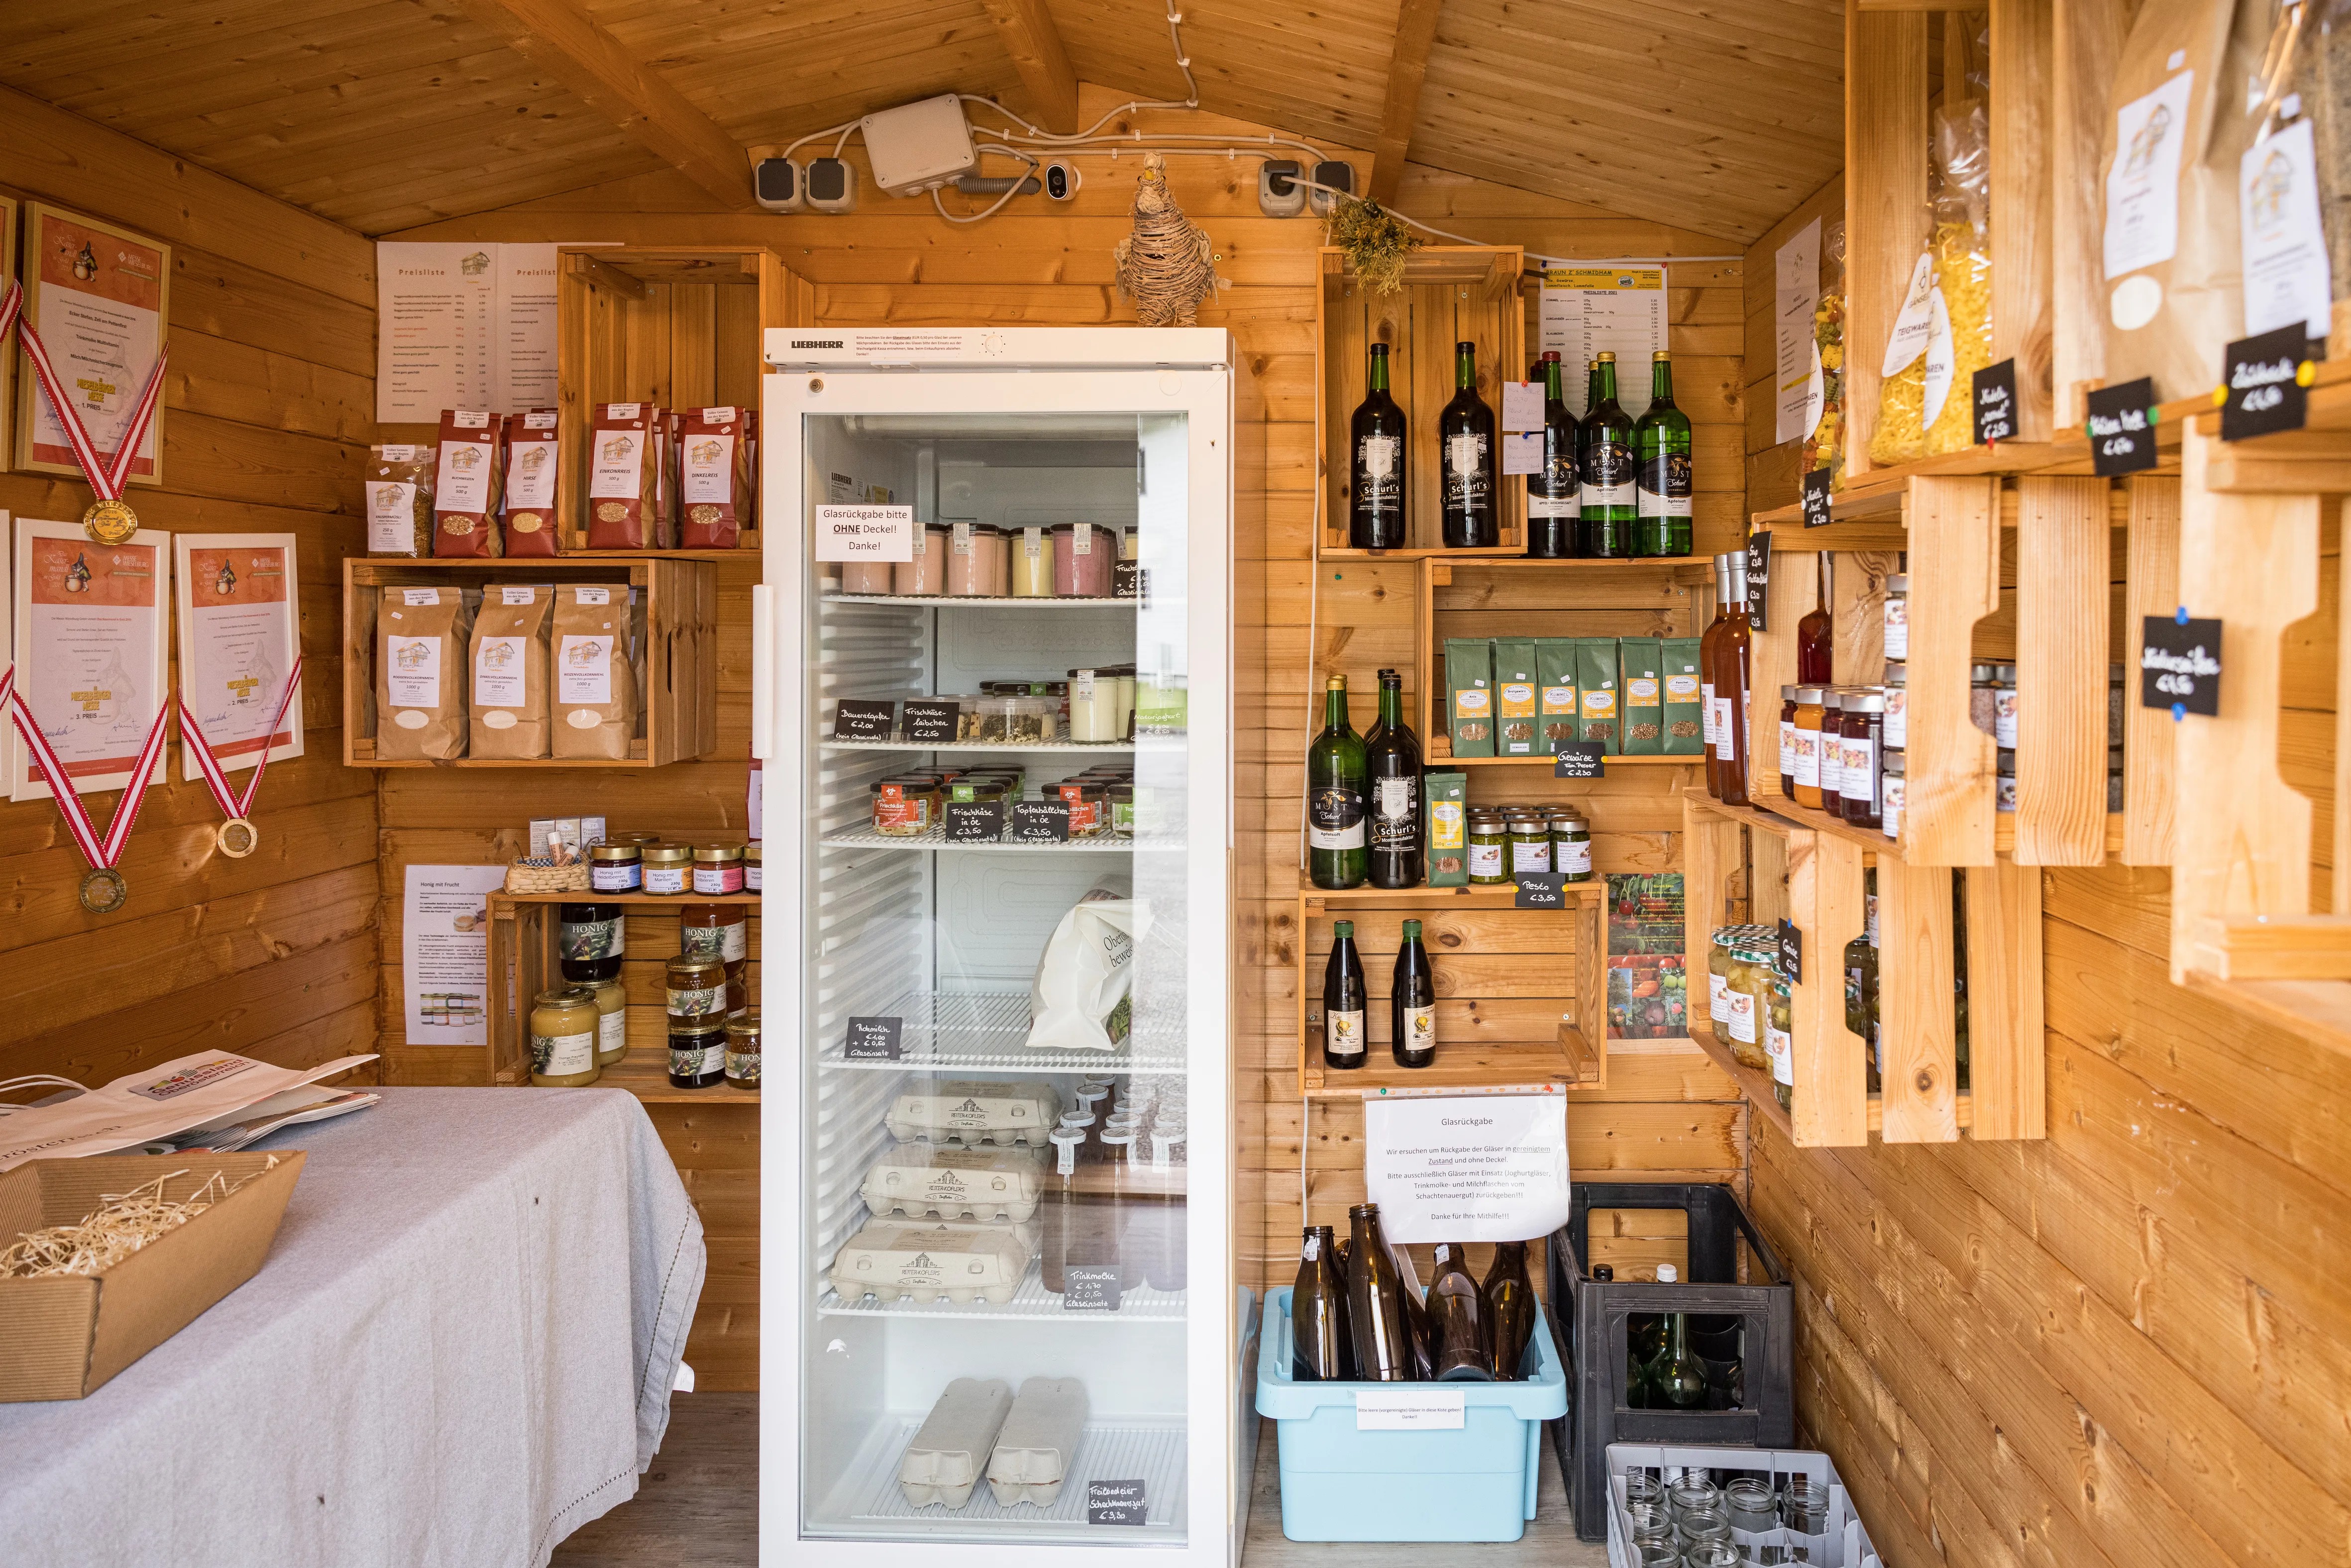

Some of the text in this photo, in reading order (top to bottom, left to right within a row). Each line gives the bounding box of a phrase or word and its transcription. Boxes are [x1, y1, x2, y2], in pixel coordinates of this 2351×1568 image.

[76, 334, 96, 343] Trinkmolke
[831, 473, 852, 485] LIEBHERR
[824, 510, 883, 520] Glasrückgabe
[833, 525, 860, 533] OHNE
[1558, 751, 1594, 762] Gewürze
[952, 808, 994, 817] Frischkäse
[1015, 805, 1069, 815] Topfenbällchen
[1523, 881, 1549, 891] Pesto
[572, 924, 608, 933] HONIG
[684, 989, 713, 998] HONIG
[856, 1024, 890, 1033] Rohmilch
[151, 1058, 244, 1095] Genussland
[158, 1061, 250, 1097] Oberösterreich
[1442, 1118, 1493, 1127] Glasrückgabe
[1070, 1270, 1116, 1280] Trinkmolke
[1089, 1485, 1137, 1495] Freilandeier
